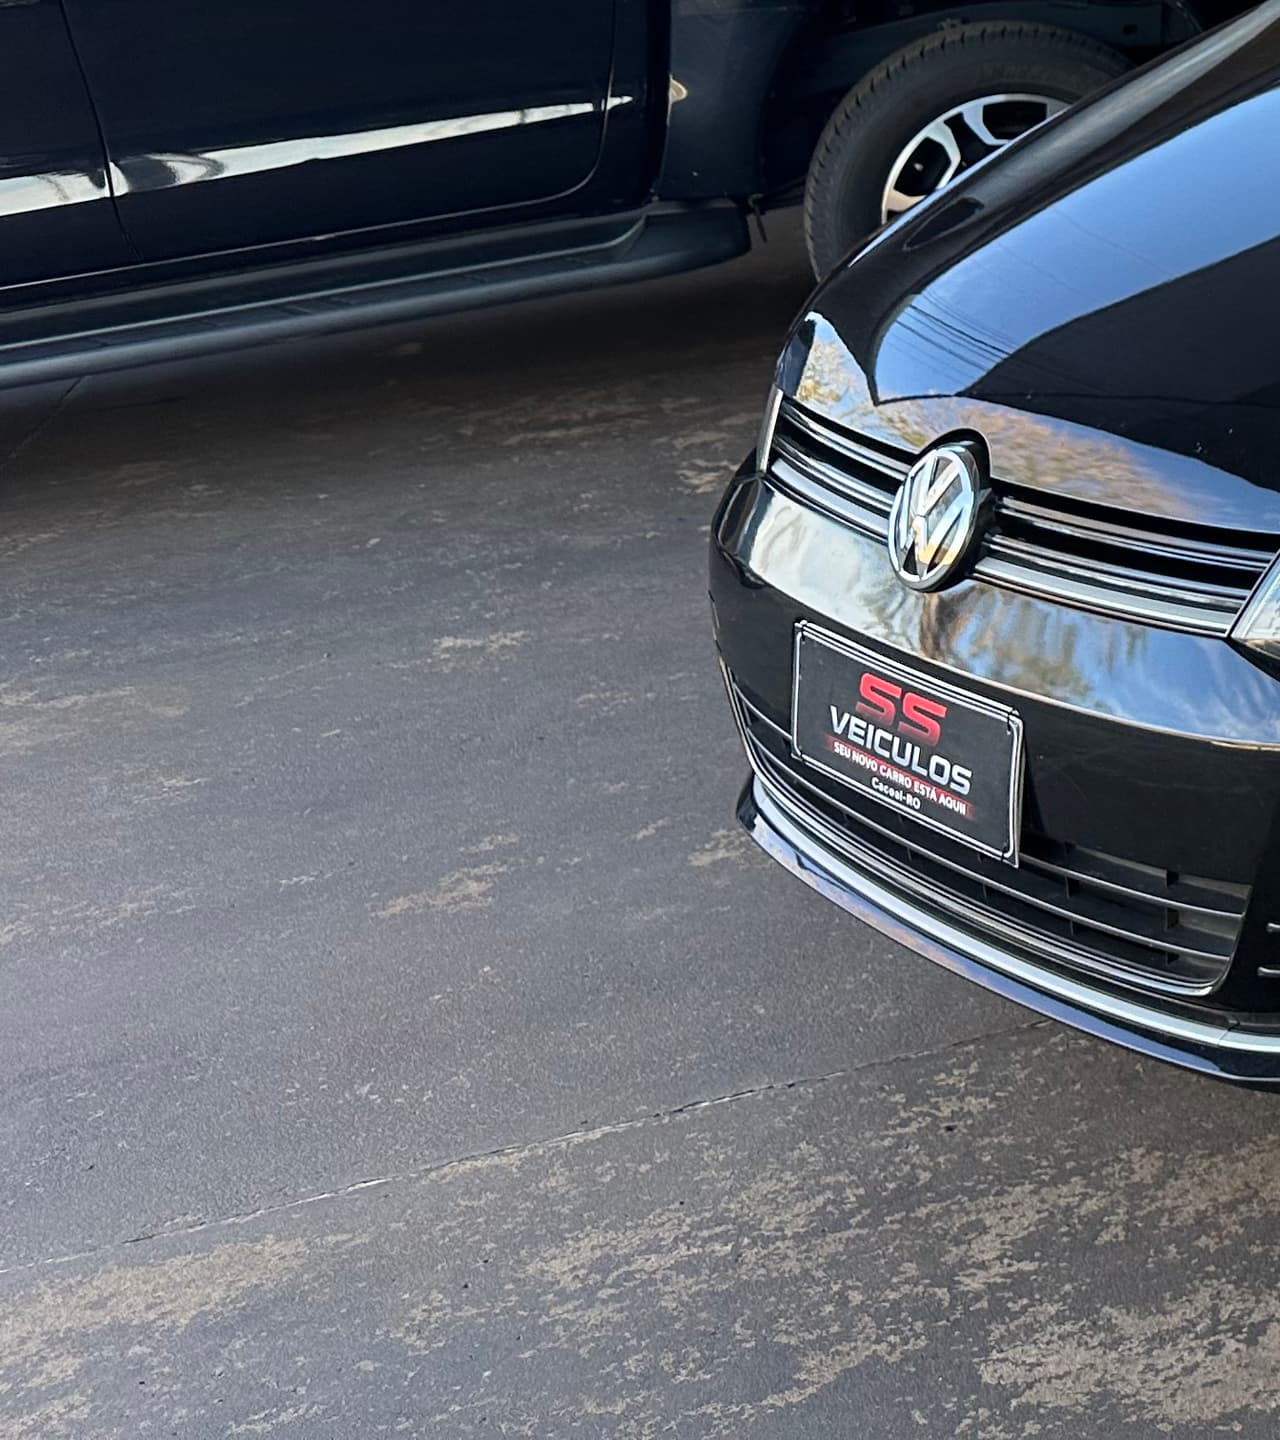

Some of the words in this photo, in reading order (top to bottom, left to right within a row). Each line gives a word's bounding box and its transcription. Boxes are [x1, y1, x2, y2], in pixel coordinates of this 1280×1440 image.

[855, 672, 947, 746] SS
[833, 741, 851, 759] SEU
[852, 750, 878, 771] NOVO
[879, 765, 912, 789] CARRO
[871, 777, 921, 810] Cacoal-RO
